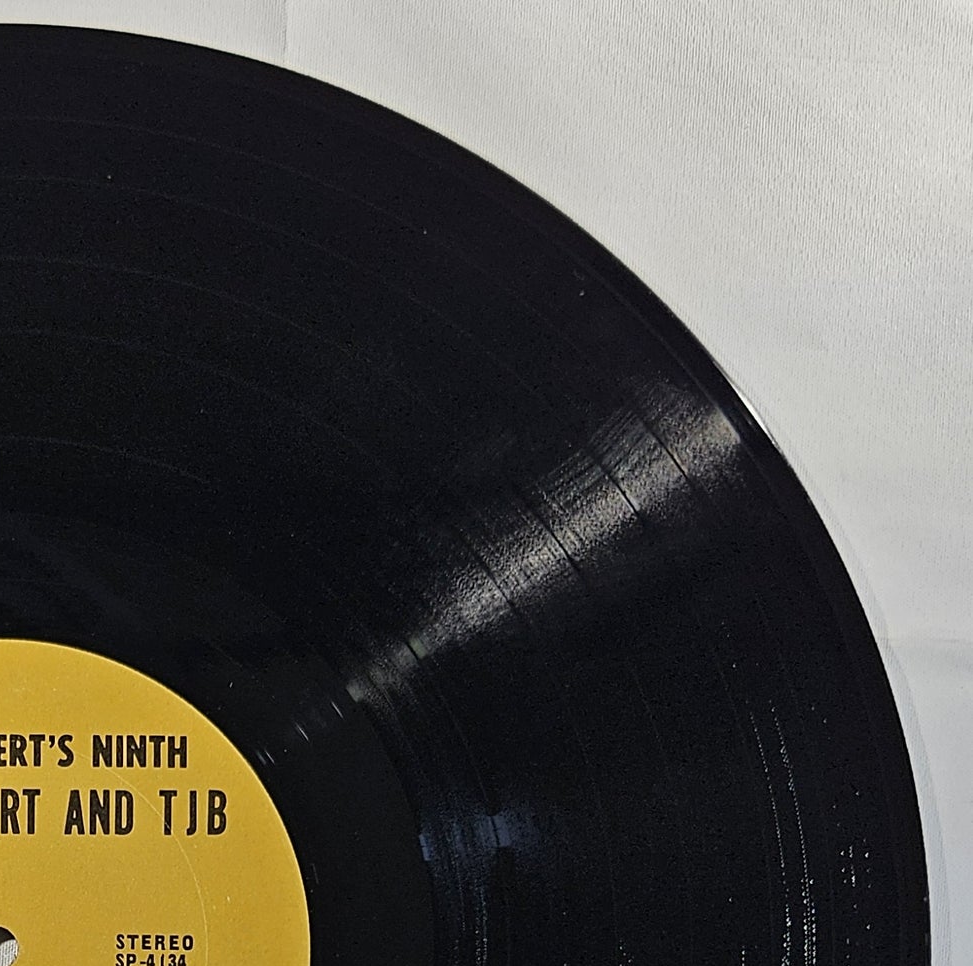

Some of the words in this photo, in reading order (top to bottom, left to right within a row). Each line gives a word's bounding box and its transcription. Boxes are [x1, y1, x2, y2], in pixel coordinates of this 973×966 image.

[93, 735, 187, 768] NINTH
[65, 790, 133, 835] AND
[116, 934, 193, 950] STEREO
